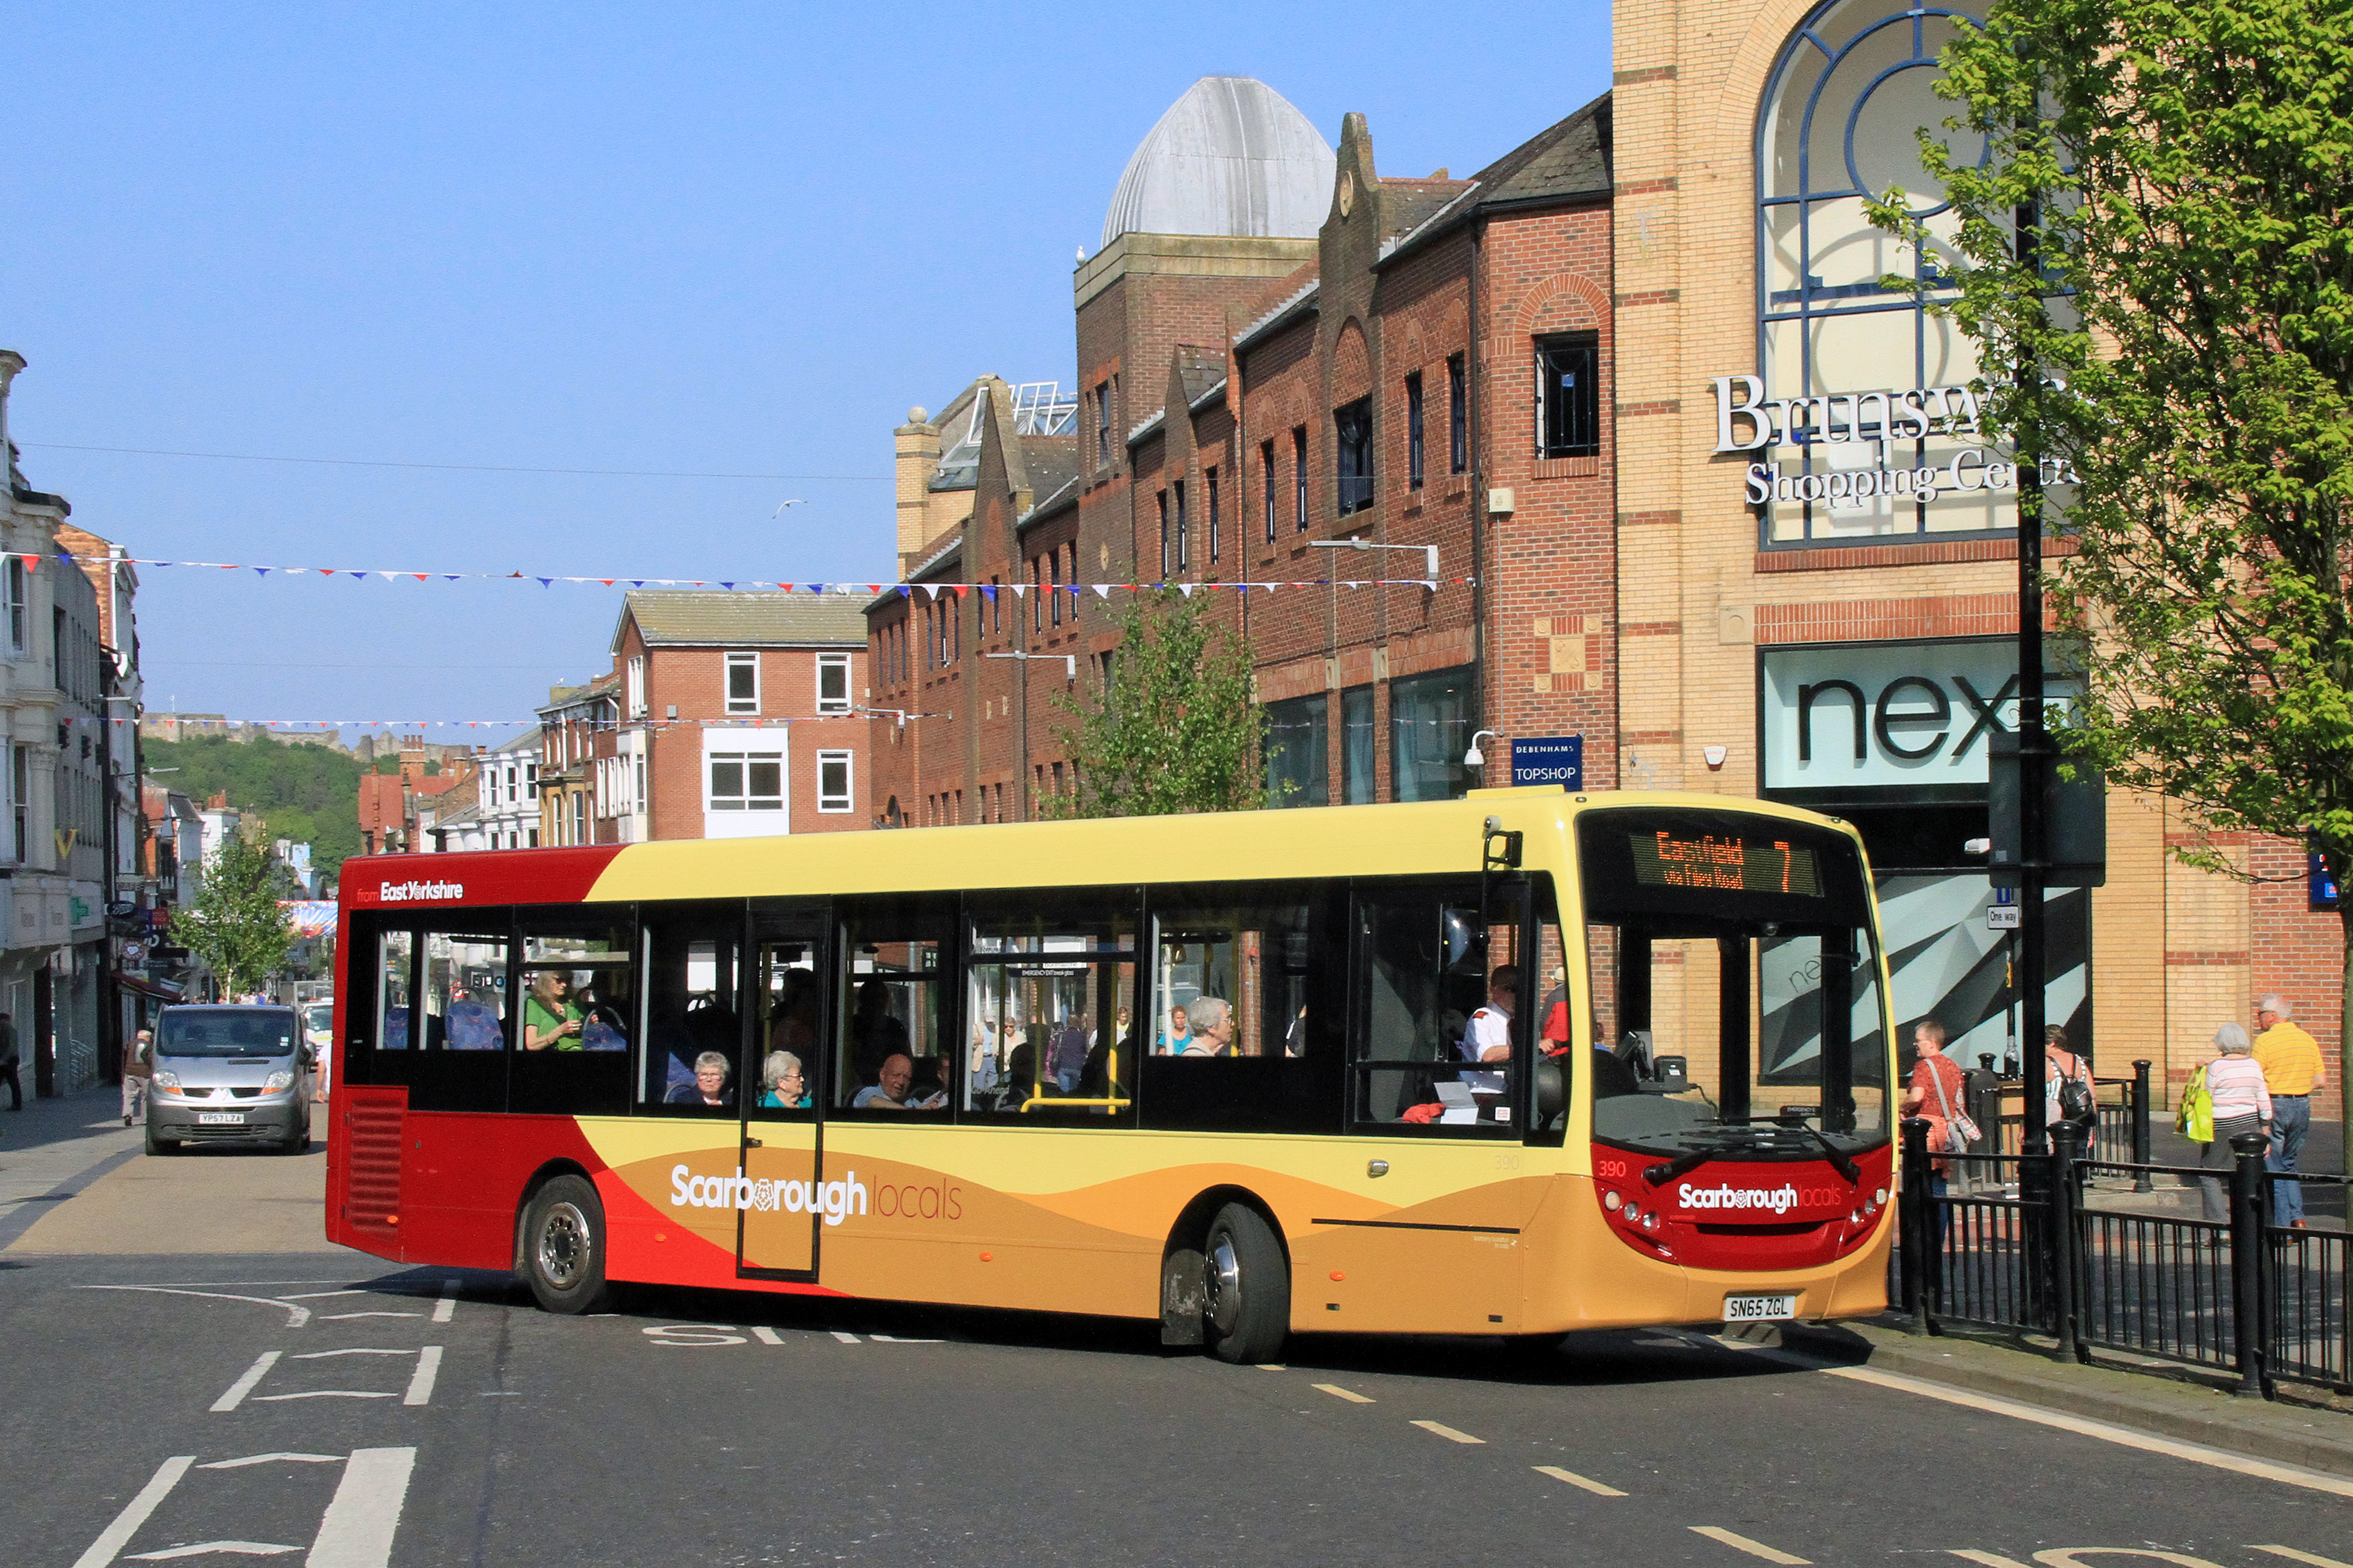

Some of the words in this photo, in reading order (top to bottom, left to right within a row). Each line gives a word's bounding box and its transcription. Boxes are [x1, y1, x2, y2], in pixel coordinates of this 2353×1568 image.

[1707, 374, 2120, 452] Brunsw
[1745, 456, 1937, 509] Shopping
[1949, 449, 2086, 491] Cetr
[1798, 675, 2070, 761] nex
[1515, 767, 1576, 781] TOPSHOP
[1656, 831, 1744, 865] Eastfield
[1664, 865, 1684, 885] via
[1714, 866, 1743, 889] Road
[1775, 841, 1791, 892] 7
[357, 889, 379, 902] from
[1990, 911, 2002, 921] One
[2005, 913, 2017, 923] way
[1495, 1155, 1520, 1170] 390
[1599, 1160, 1626, 1177] 390
[671, 1165, 867, 1226] Scarborough
[872, 1175, 962, 1220] locals
[1679, 1183, 1797, 1215] Scarborough
[1799, 1183, 1841, 1207] locals
[1730, 1299, 1763, 1317] SN65
[1766, 1297, 1788, 1316] ZGL
